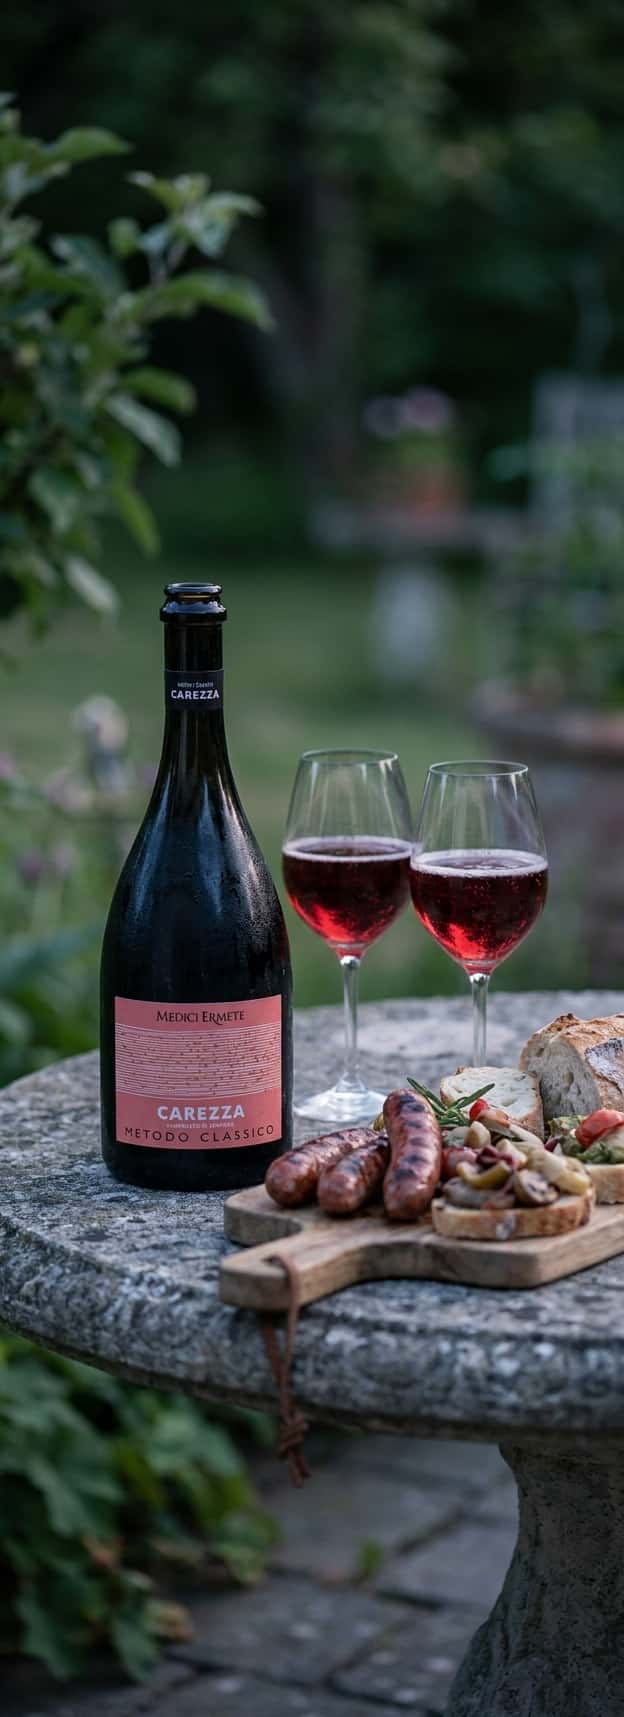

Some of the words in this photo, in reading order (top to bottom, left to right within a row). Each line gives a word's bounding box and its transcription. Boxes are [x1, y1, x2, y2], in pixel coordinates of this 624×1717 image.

[171, 689, 220, 700] CAREZZA
[157, 1104, 245, 1121] CAREZZA
[124, 1127, 189, 1143] METODO
[200, 1124, 275, 1143] CLASSICO
